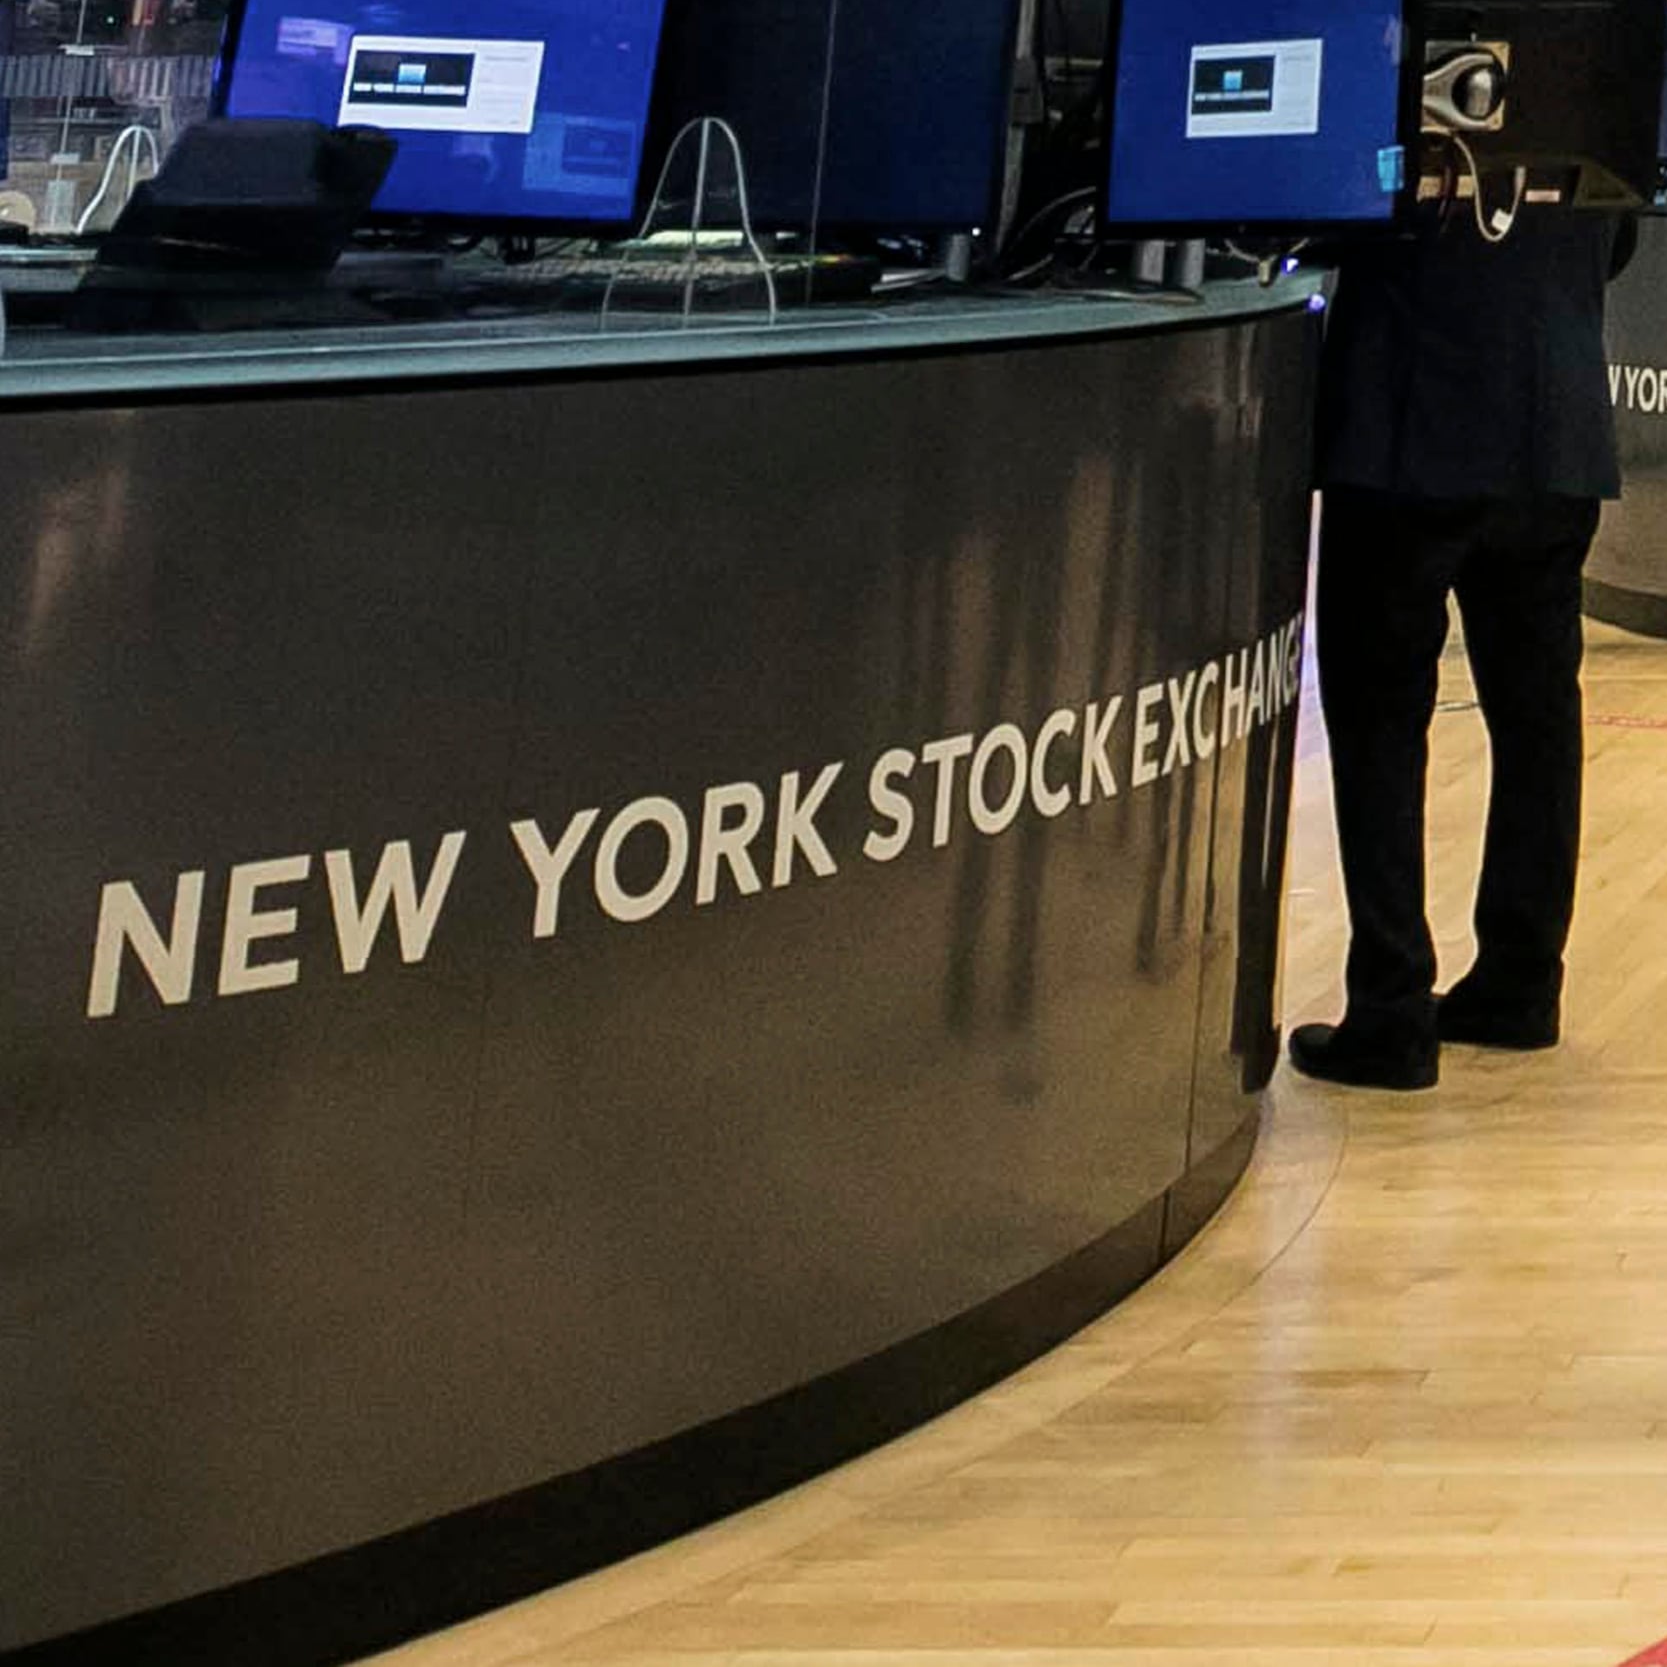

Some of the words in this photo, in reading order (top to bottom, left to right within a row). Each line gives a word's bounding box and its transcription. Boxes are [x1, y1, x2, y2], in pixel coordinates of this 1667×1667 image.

[86, 829, 467, 1019] NEW
[509, 762, 845, 939] YORK
[862, 693, 1124, 864] STOCK
[1131, 611, 1303, 787] EXCHANG
